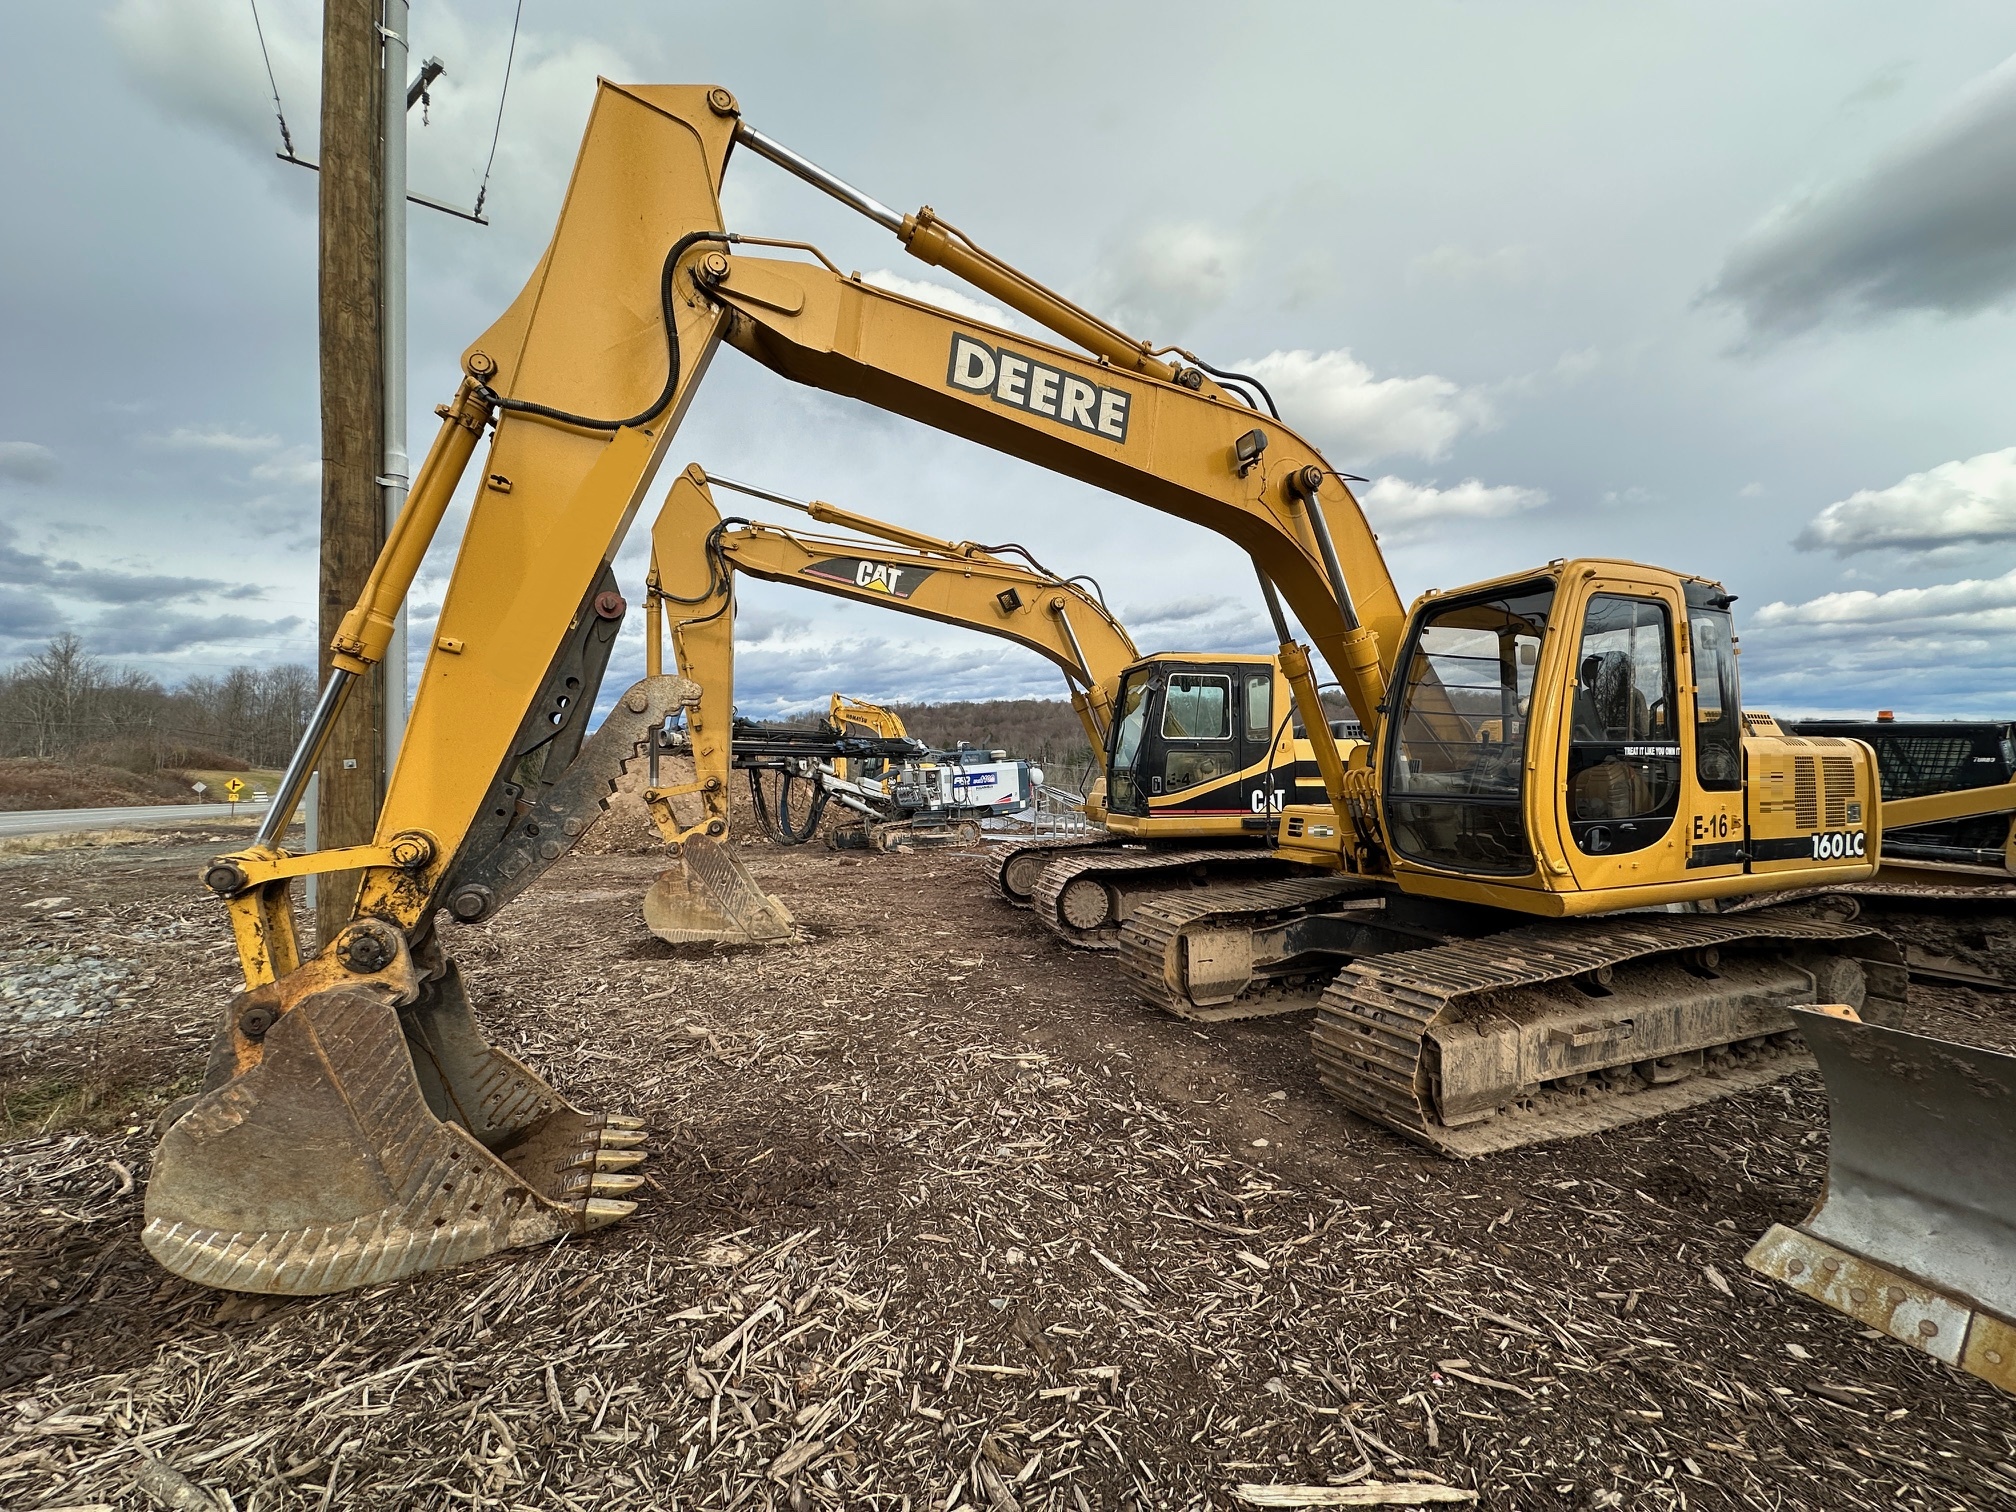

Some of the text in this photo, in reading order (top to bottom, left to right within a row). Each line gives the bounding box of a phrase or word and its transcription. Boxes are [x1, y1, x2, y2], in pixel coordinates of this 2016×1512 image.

[953, 338, 1126, 438] DEERE
[856, 560, 902, 595] CAT
[1624, 746, 1639, 756] TREAT
[1644, 746, 1655, 756] LIKE
[1655, 746, 1665, 756] YOU
[1693, 813, 1728, 840] E-16
[1812, 832, 1865, 860] 160LC
